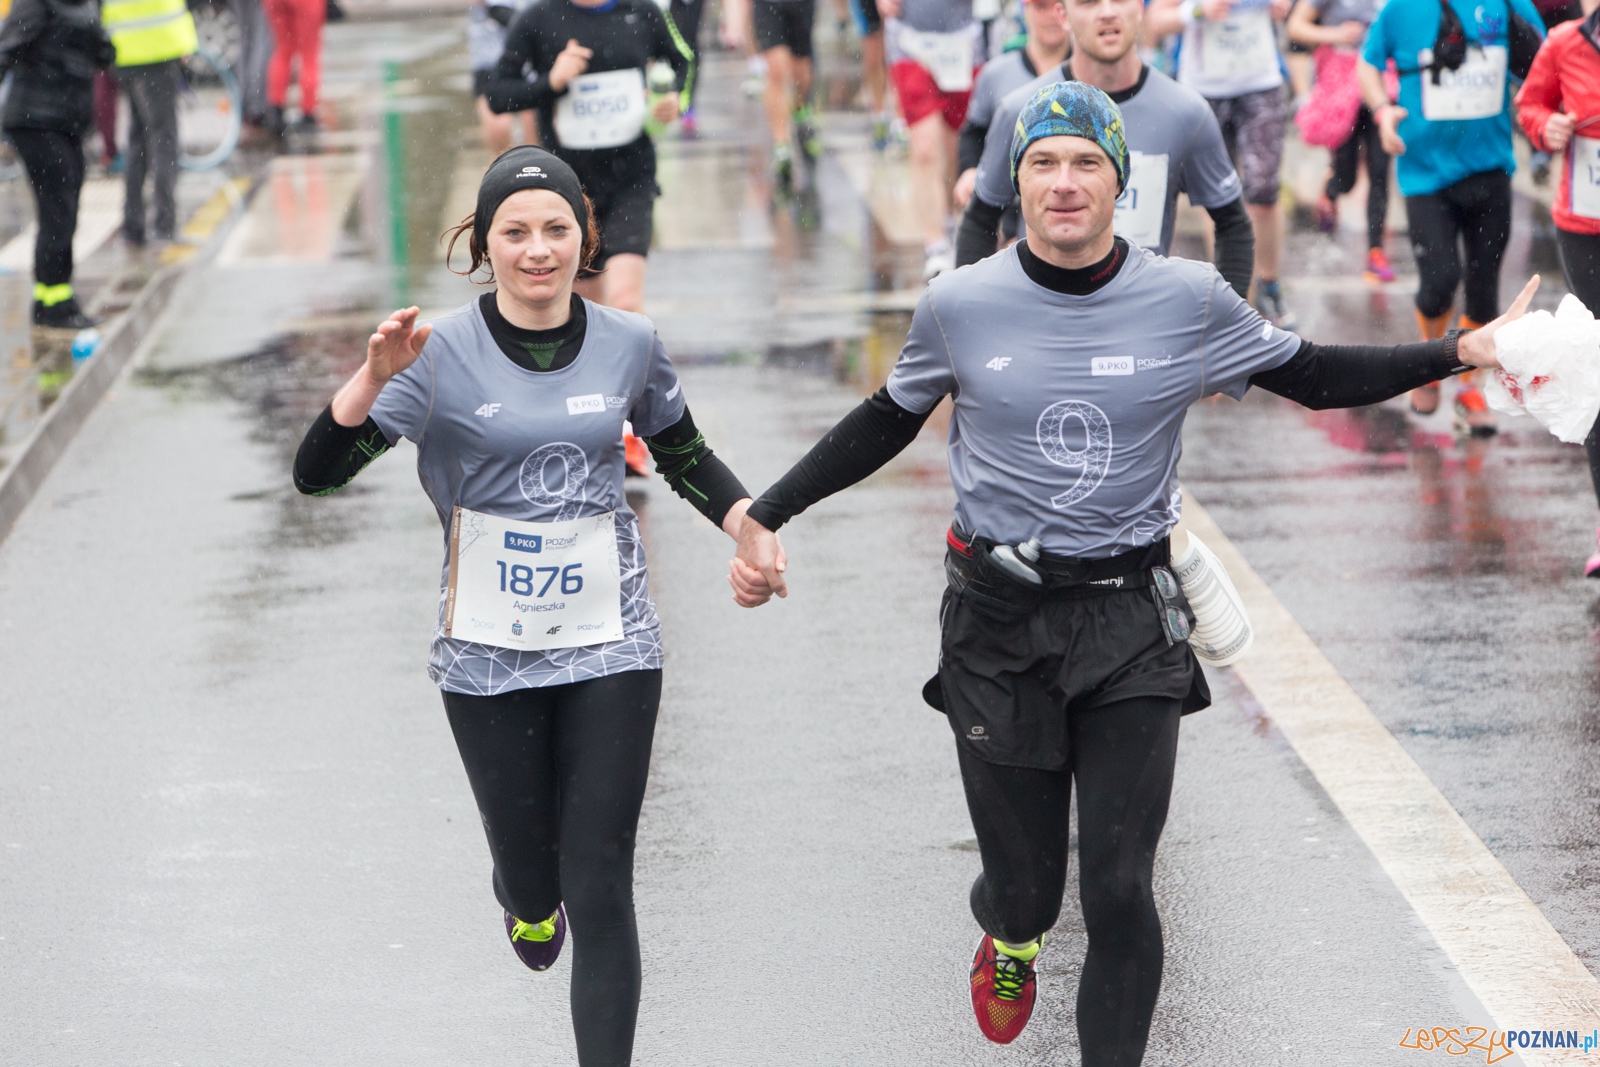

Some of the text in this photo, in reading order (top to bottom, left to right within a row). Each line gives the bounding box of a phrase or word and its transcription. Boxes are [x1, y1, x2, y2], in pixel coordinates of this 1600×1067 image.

[572, 94, 629, 118] 8050
[1115, 187, 1138, 210] 21
[985, 356, 1013, 371] 4F
[474, 402, 502, 418] 4F
[1036, 399, 1113, 509] 9
[509, 536, 537, 549] 9.PKO
[496, 560, 584, 598] 1876
[512, 600, 566, 613] Agnieszka
